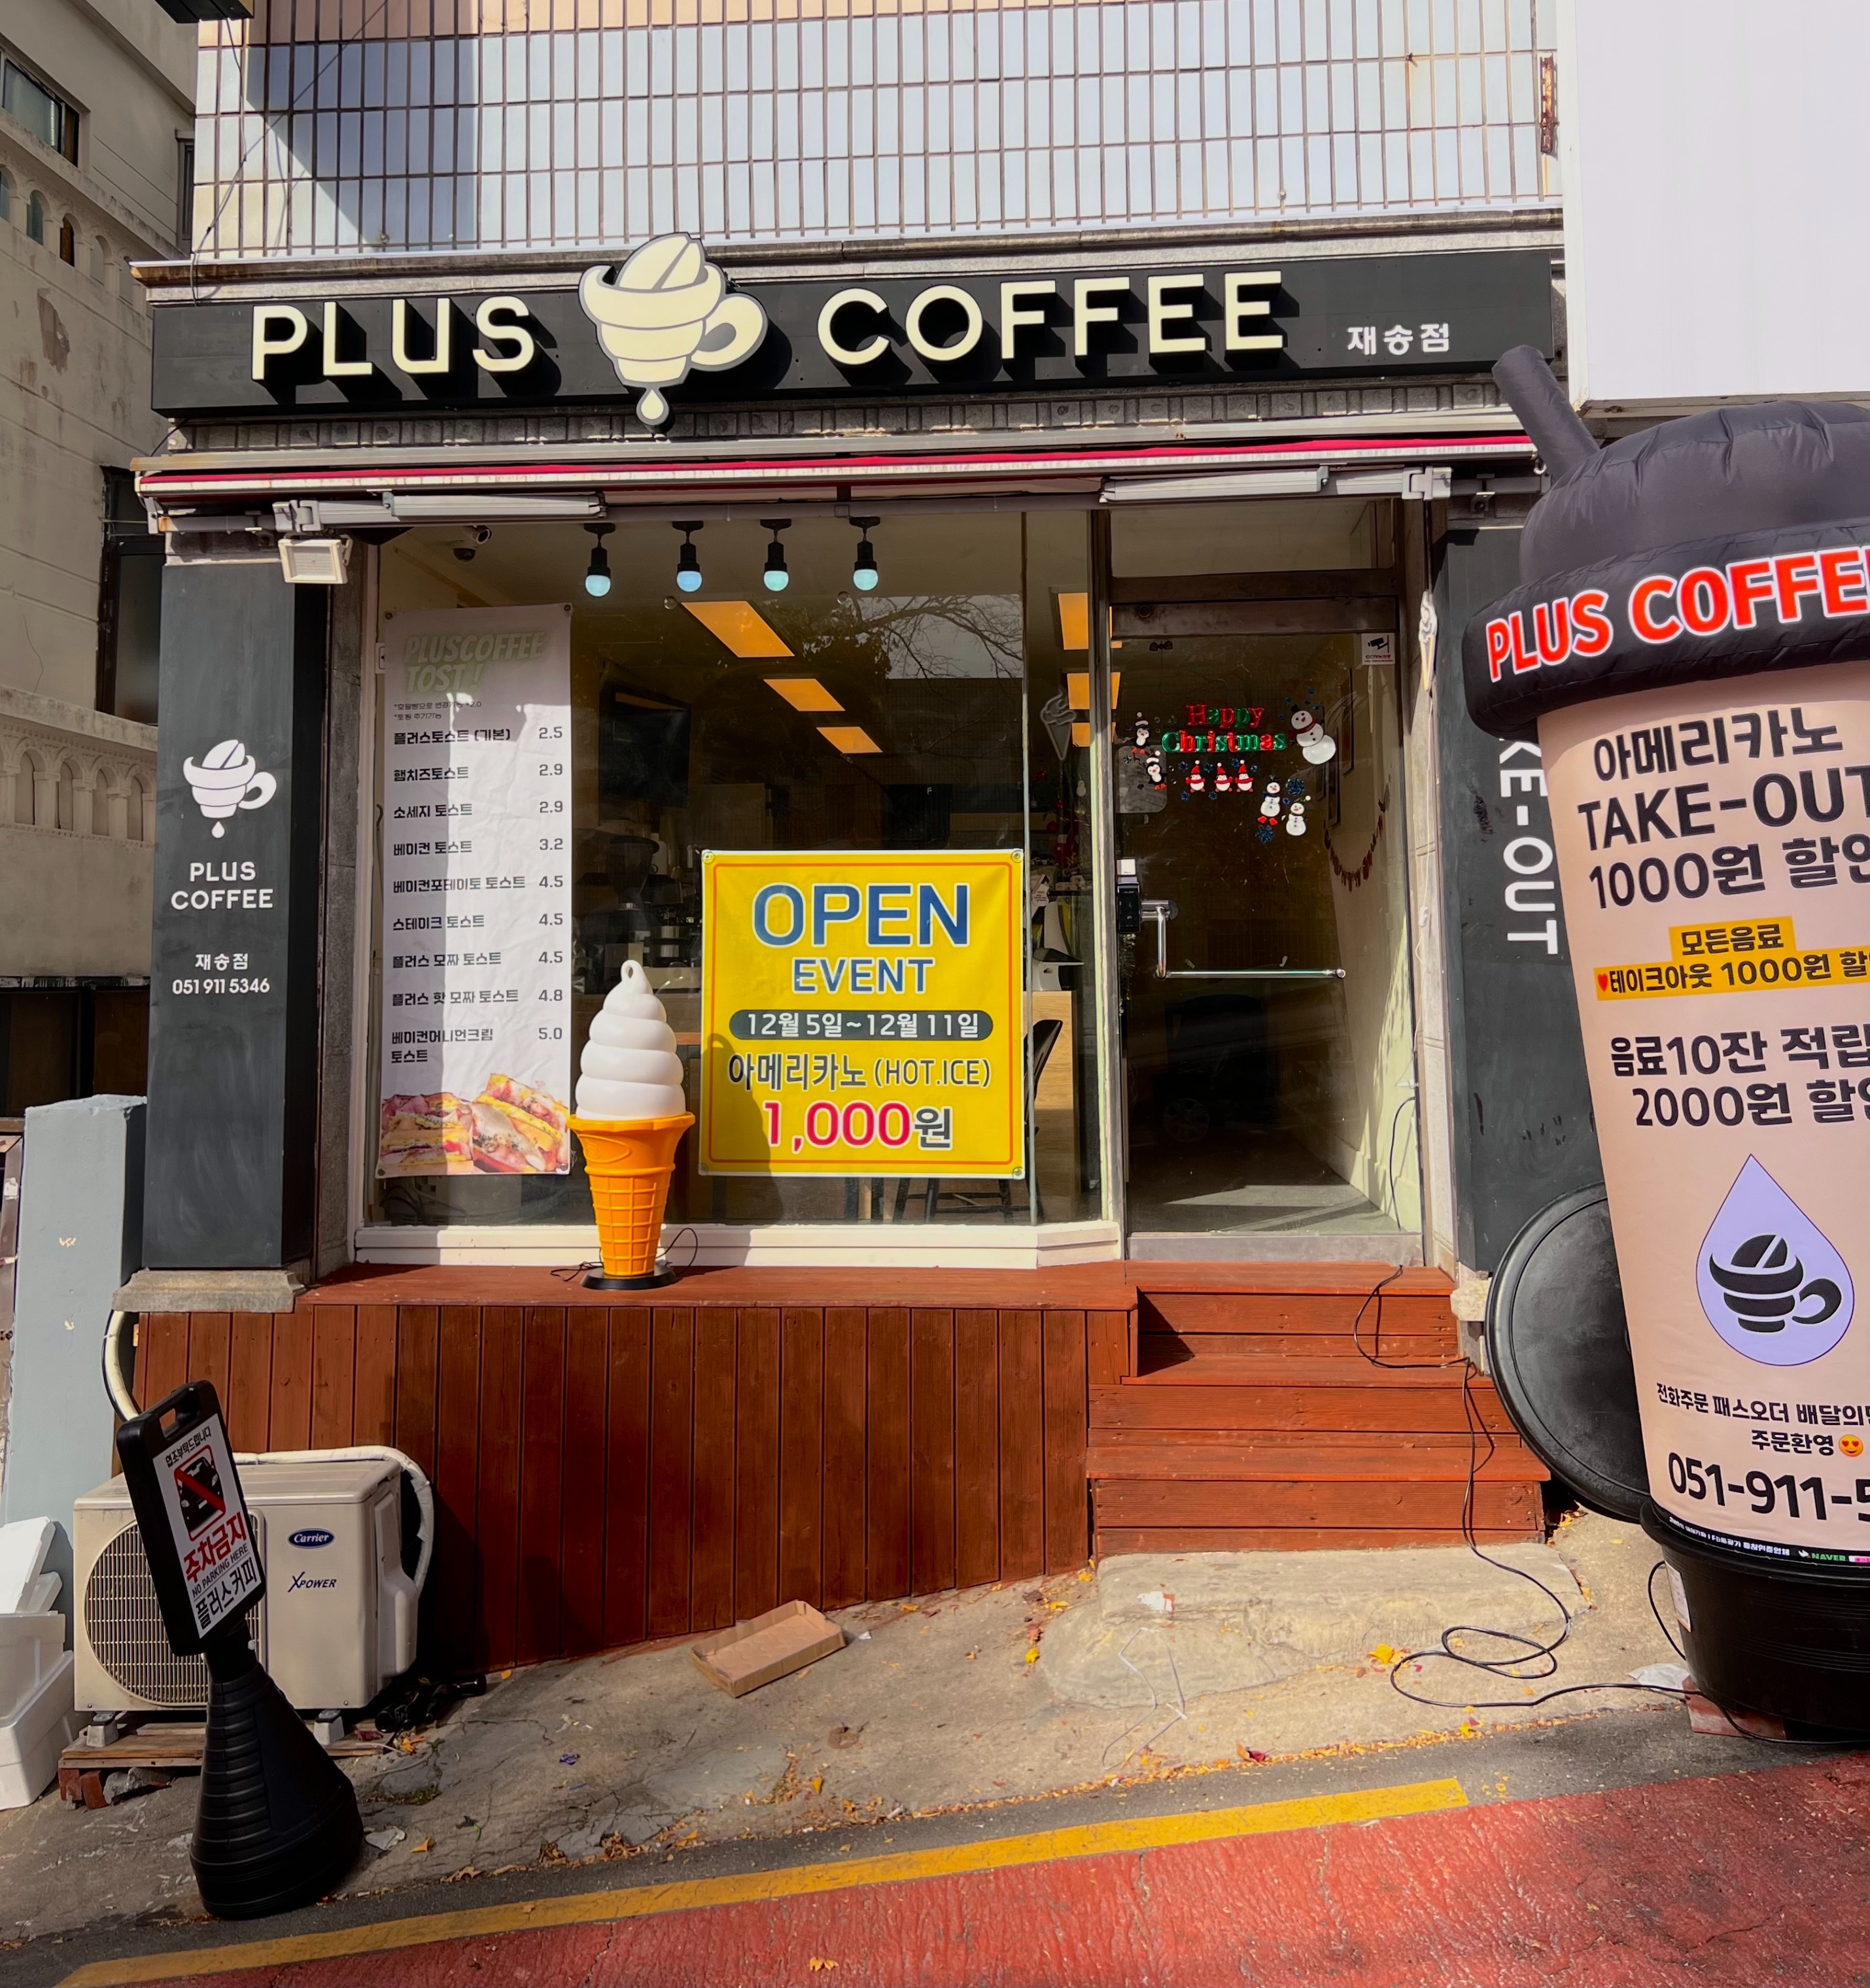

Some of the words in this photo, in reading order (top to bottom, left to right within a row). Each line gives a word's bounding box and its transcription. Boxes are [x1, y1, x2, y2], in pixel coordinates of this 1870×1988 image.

[251, 296, 535, 380] PLUS
[817, 270, 1283, 365] COFFEE
[1347, 323, 1449, 355] 재송점
[1486, 589, 1614, 683] PLUS
[1628, 545, 1870, 644] COFFE
[405, 630, 547, 664] PLUSCOFFEE
[1186, 703, 1265, 728] Happy
[394, 730, 469, 745] 플러스토스트
[474, 728, 511, 741] (기본)
[539, 727, 563, 739] 2.5
[1161, 729, 1287, 753] Christmas
[1593, 707, 1843, 781] 아메리카노
[394, 766, 468, 781] 햄치즈토스트
[539, 763, 563, 776] 2.9
[394, 805, 430, 819] 소세지
[435, 804, 472, 816] 토스트
[539, 800, 563, 813] 2.9
[1577, 766, 1870, 851] TAKE-OUT
[394, 842, 430, 856] 베이컨
[435, 841, 472, 853] 토스트
[539, 838, 564, 851] 3.2
[190, 861, 256, 882] PLUS
[393, 878, 481, 893] 베이컨포테이토
[485, 876, 525, 889] 토스트
[539, 875, 563, 888] 4.5
[1589, 844, 1765, 908] 1000원
[171, 889, 273, 910] COFFEE
[392, 917, 442, 931] 스테이크
[447, 915, 485, 928] 토스트
[539, 913, 563, 925] 4.5
[752, 882, 970, 948] OPEN
[1681, 923, 1784, 956] 모든음료
[195, 953, 249, 971] 재송점
[392, 954, 429, 968] 플러스
[434, 953, 459, 967] 모짜
[463, 952, 501, 965] 토스트
[538, 951, 563, 963] 4.5
[1610, 963, 1712, 993] 테이크아웃
[1720, 953, 1831, 985] 1000원
[1839, 950, 1870, 977] 할
[172, 980, 199, 995] 051
[203, 979, 225, 995] 911
[229, 978, 270, 994] 5346
[792, 957, 935, 994] EVENT
[392, 993, 429, 1006] 플러스
[433, 991, 445, 1004] 핫
[450, 991, 476, 1004] 모짜
[479, 989, 519, 1003] 토스트
[538, 989, 563, 1001] 4.8
[392, 1028, 493, 1044] 베이컨어니언크림
[538, 1027, 563, 1040] 5.0
[748, 1013, 799, 1037] 12월
[927, 1013, 978, 1038] 11일
[391, 1050, 428, 1063] 토스트
[1611, 1031, 1767, 1077] 음료10잔
[729, 1053, 867, 1091] 아메리카노
[874, 1058, 991, 1088] (HOT.ICE)
[1632, 1082, 1792, 1127] 2000원
[1806, 1077, 1870, 1123] 할
[763, 1101, 953, 1153] 1,000원
[1656, 1382, 1708, 1414] 전화주문
[1712, 1395, 1790, 1423] 패스오더
[1796, 1404, 1870, 1426] 배달의
[165, 1425, 211, 1468] 협조부탁드립니다
[1751, 1430, 1834, 1456] 주문환영
[183, 1511, 247, 1583] 주차금지
[294, 1533, 330, 1543] Carrier
[1811, 1552, 1846, 1562] NAVER
[192, 1583, 202, 1598] NO
[201, 1558, 230, 1588] PARKING
[230, 1543, 249, 1562] HERE
[287, 1571, 337, 1592] XPOWER
[195, 1556, 258, 1630] 플러스커피
